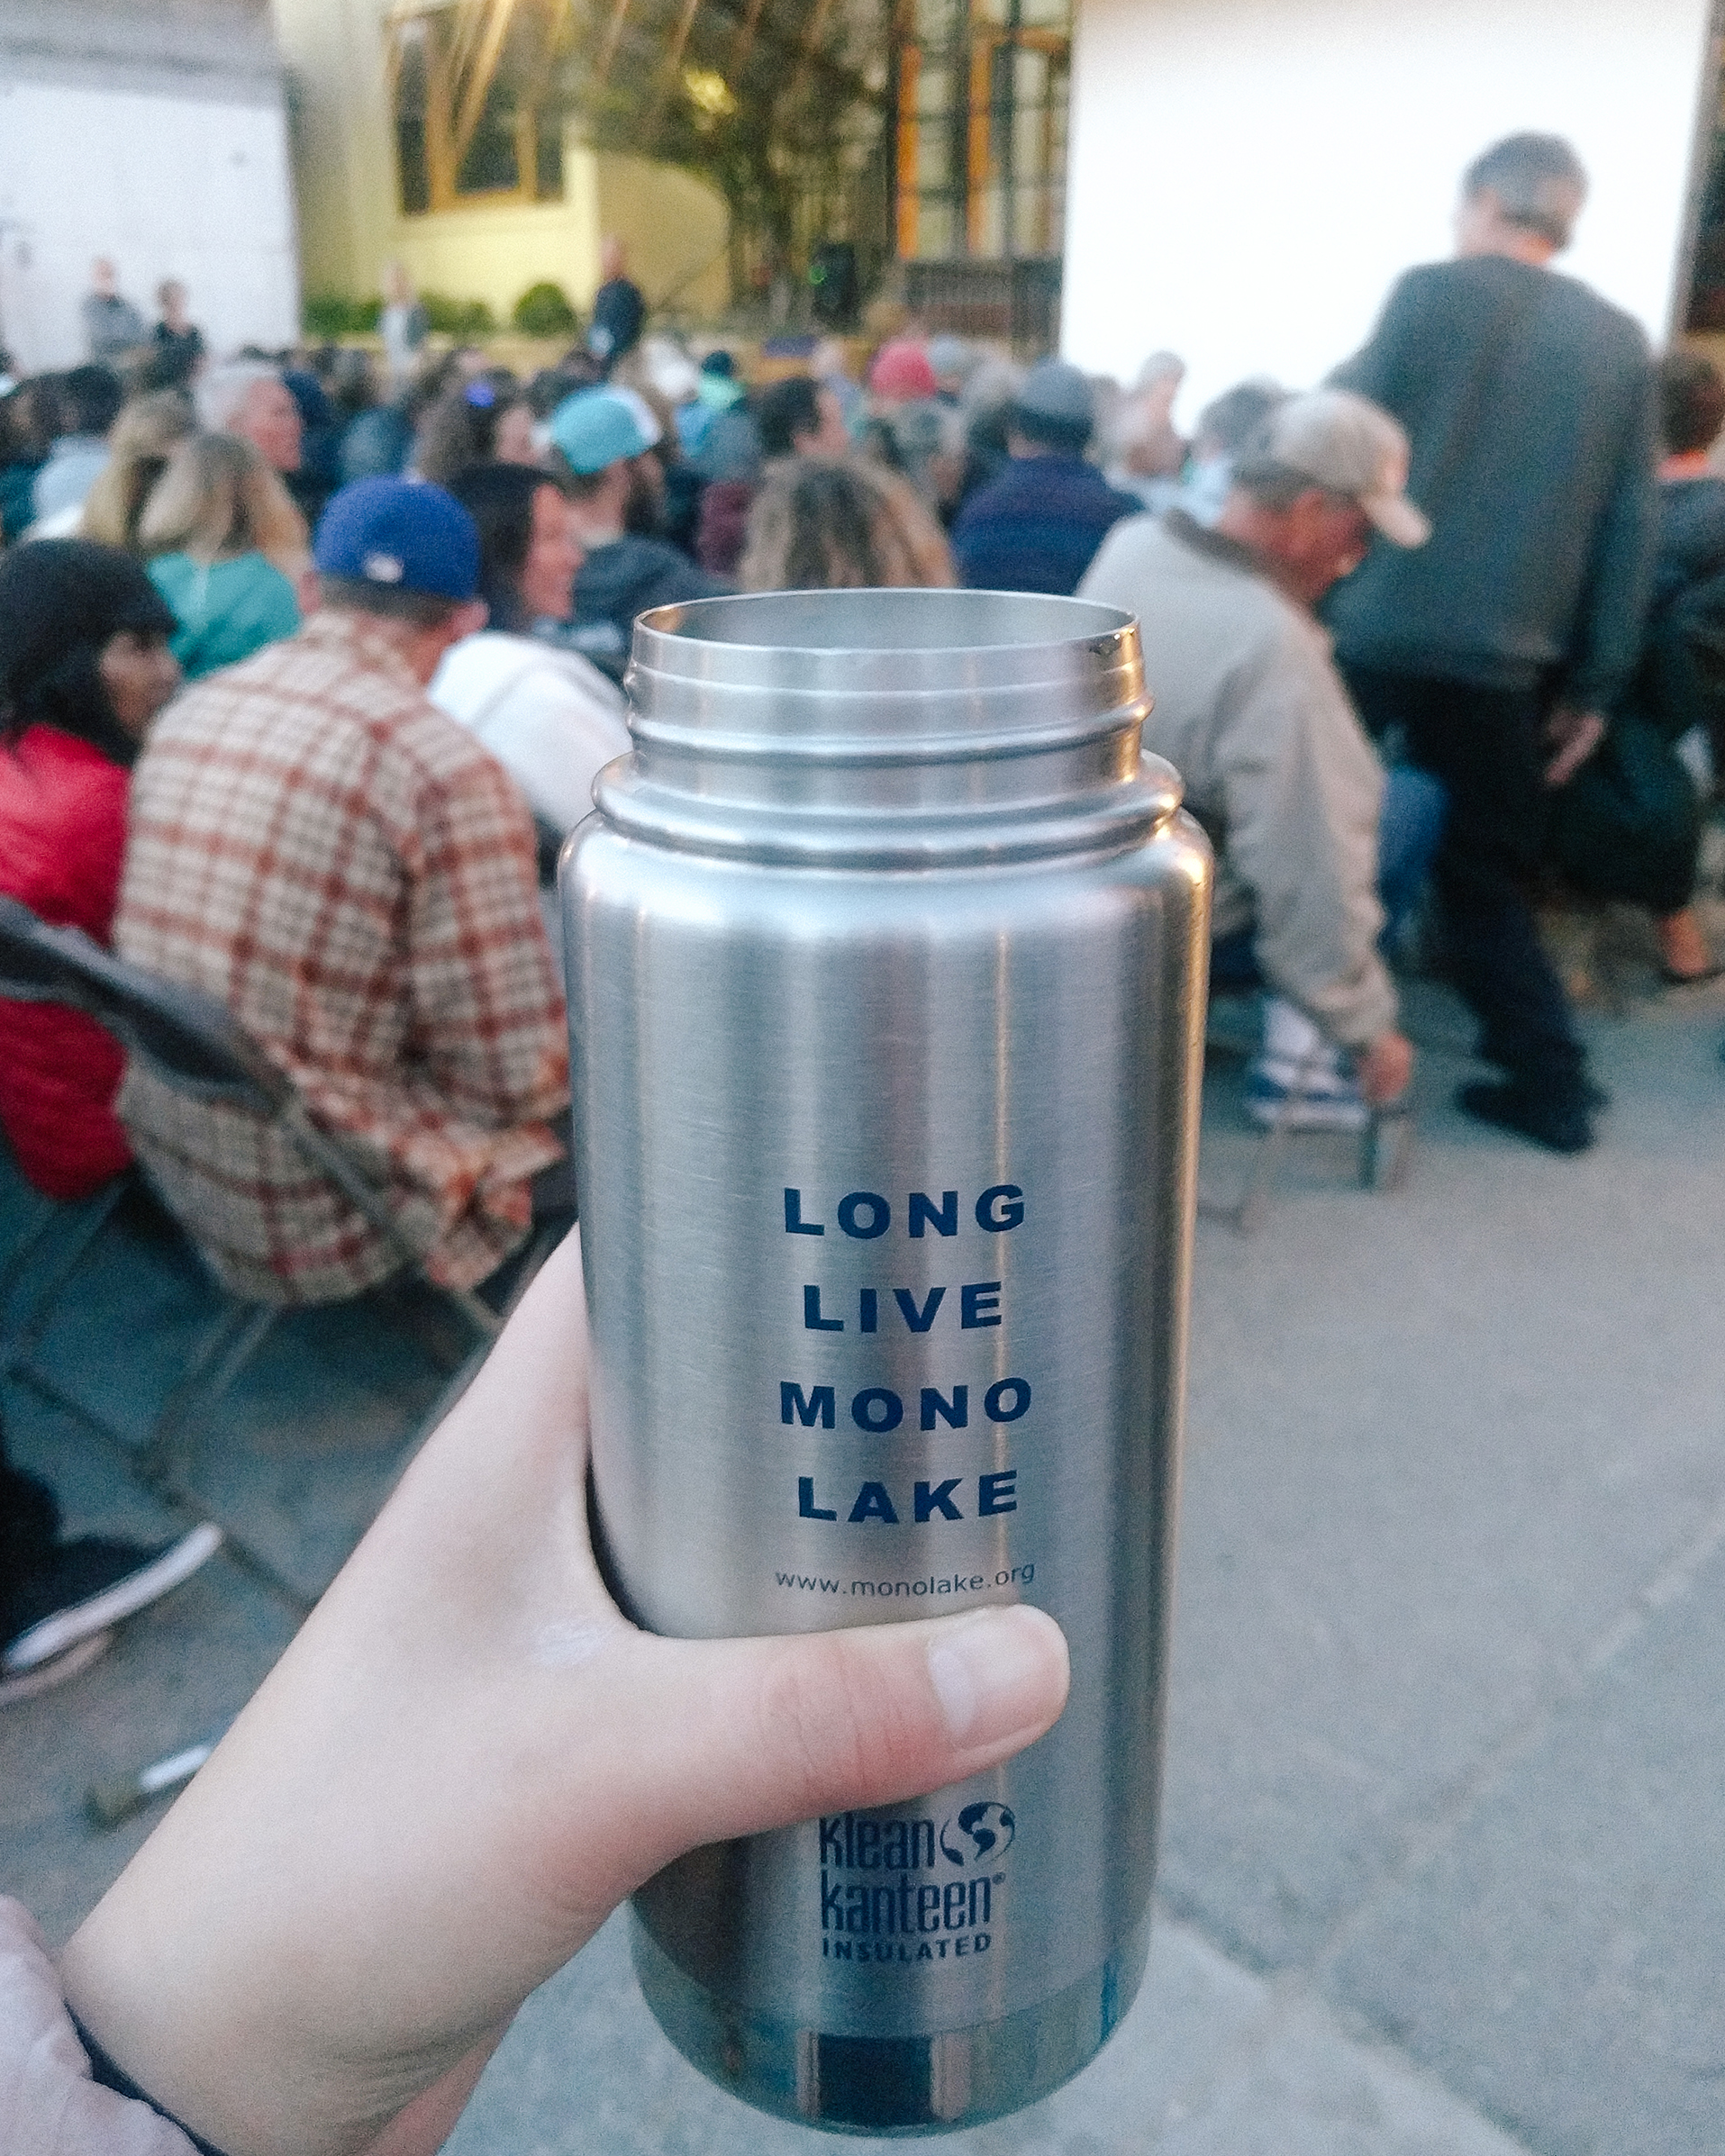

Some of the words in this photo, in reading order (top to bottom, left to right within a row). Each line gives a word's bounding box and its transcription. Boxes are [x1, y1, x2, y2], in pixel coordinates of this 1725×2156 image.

[784, 1183, 1025, 1239] LONG
[803, 1281, 1003, 1333] LIVE
[779, 1377, 1032, 1433] MONO
[797, 1469, 1019, 1524] LAKE
[775, 1562, 1036, 1598] www.monolake.org
[819, 1811, 936, 1870] klean
[822, 1933, 992, 1962] INSULATED
